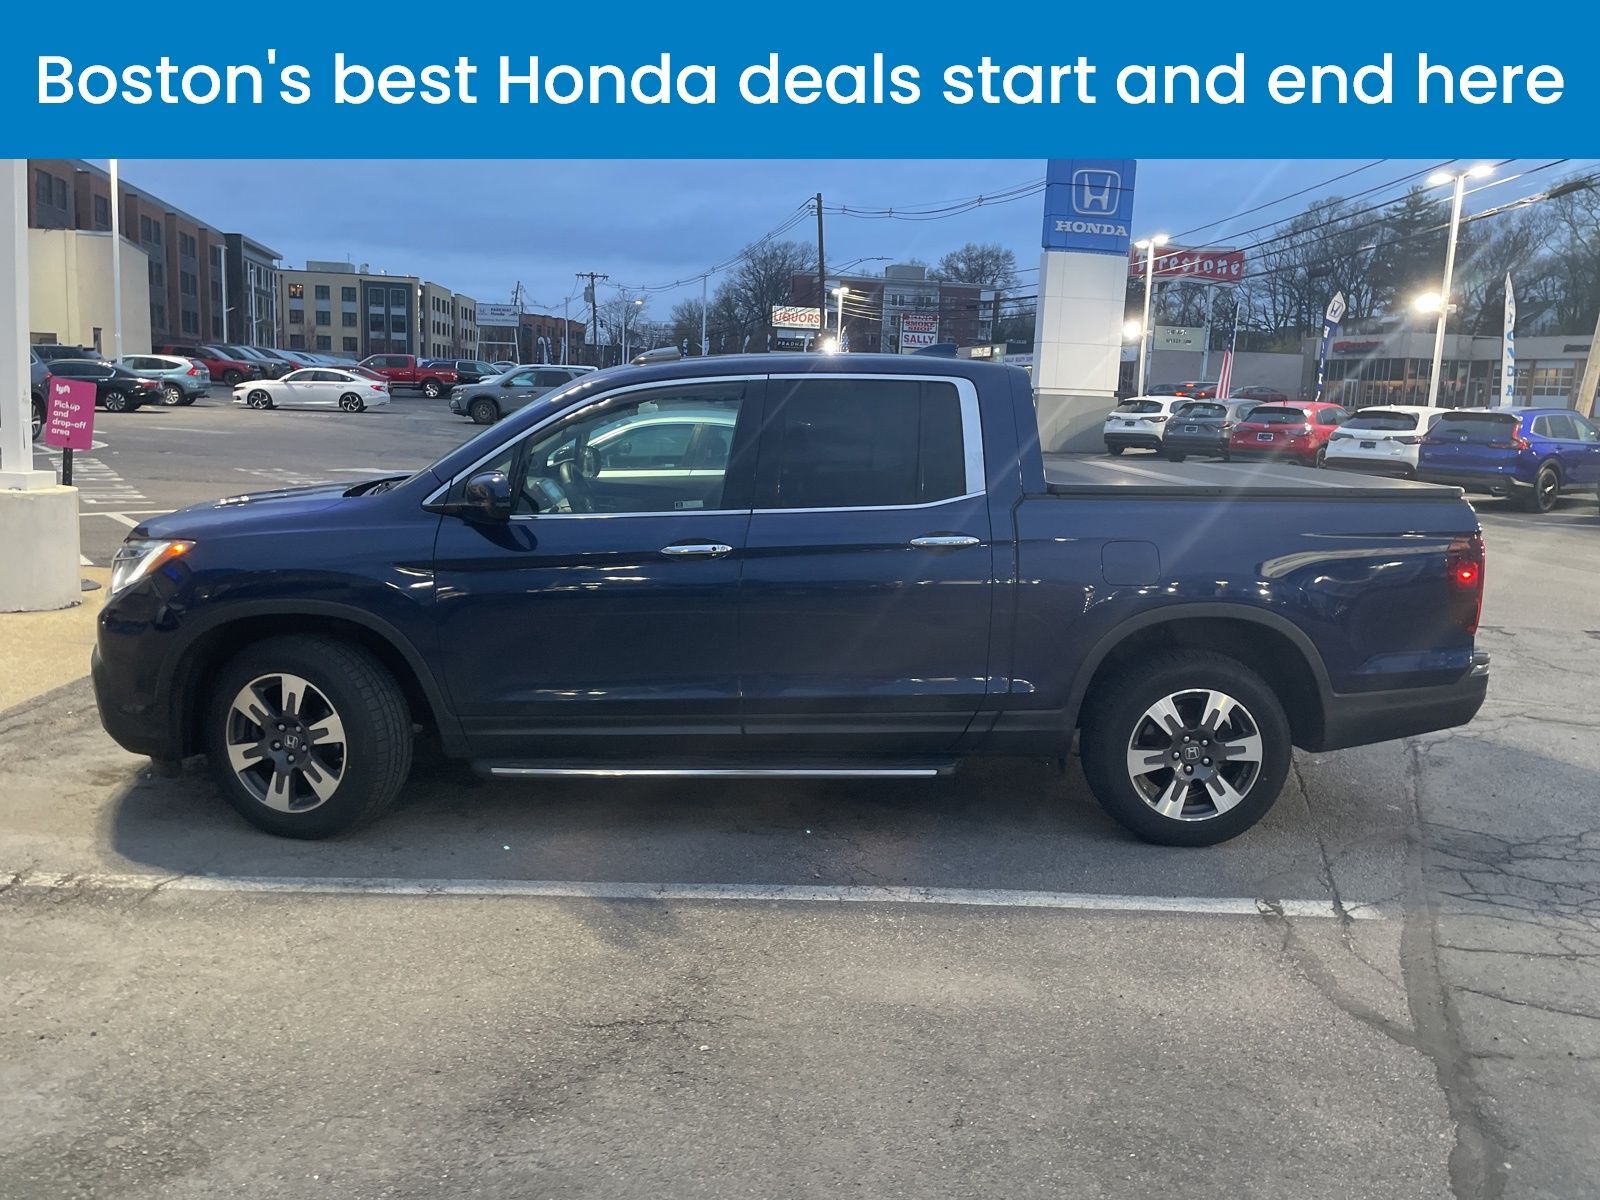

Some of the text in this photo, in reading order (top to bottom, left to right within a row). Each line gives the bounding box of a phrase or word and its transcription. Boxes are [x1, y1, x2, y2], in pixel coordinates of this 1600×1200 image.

[1055, 220, 1128, 237] HONDA
[1135, 248, 1240, 275] Frestone
[773, 312, 820, 324] LIQUORS
[903, 334, 934, 344] SALLY
[56, 384, 70, 394] lyft
[53, 410, 69, 418] and
[52, 418, 87, 429] drop-off
[51, 427, 70, 436] area
